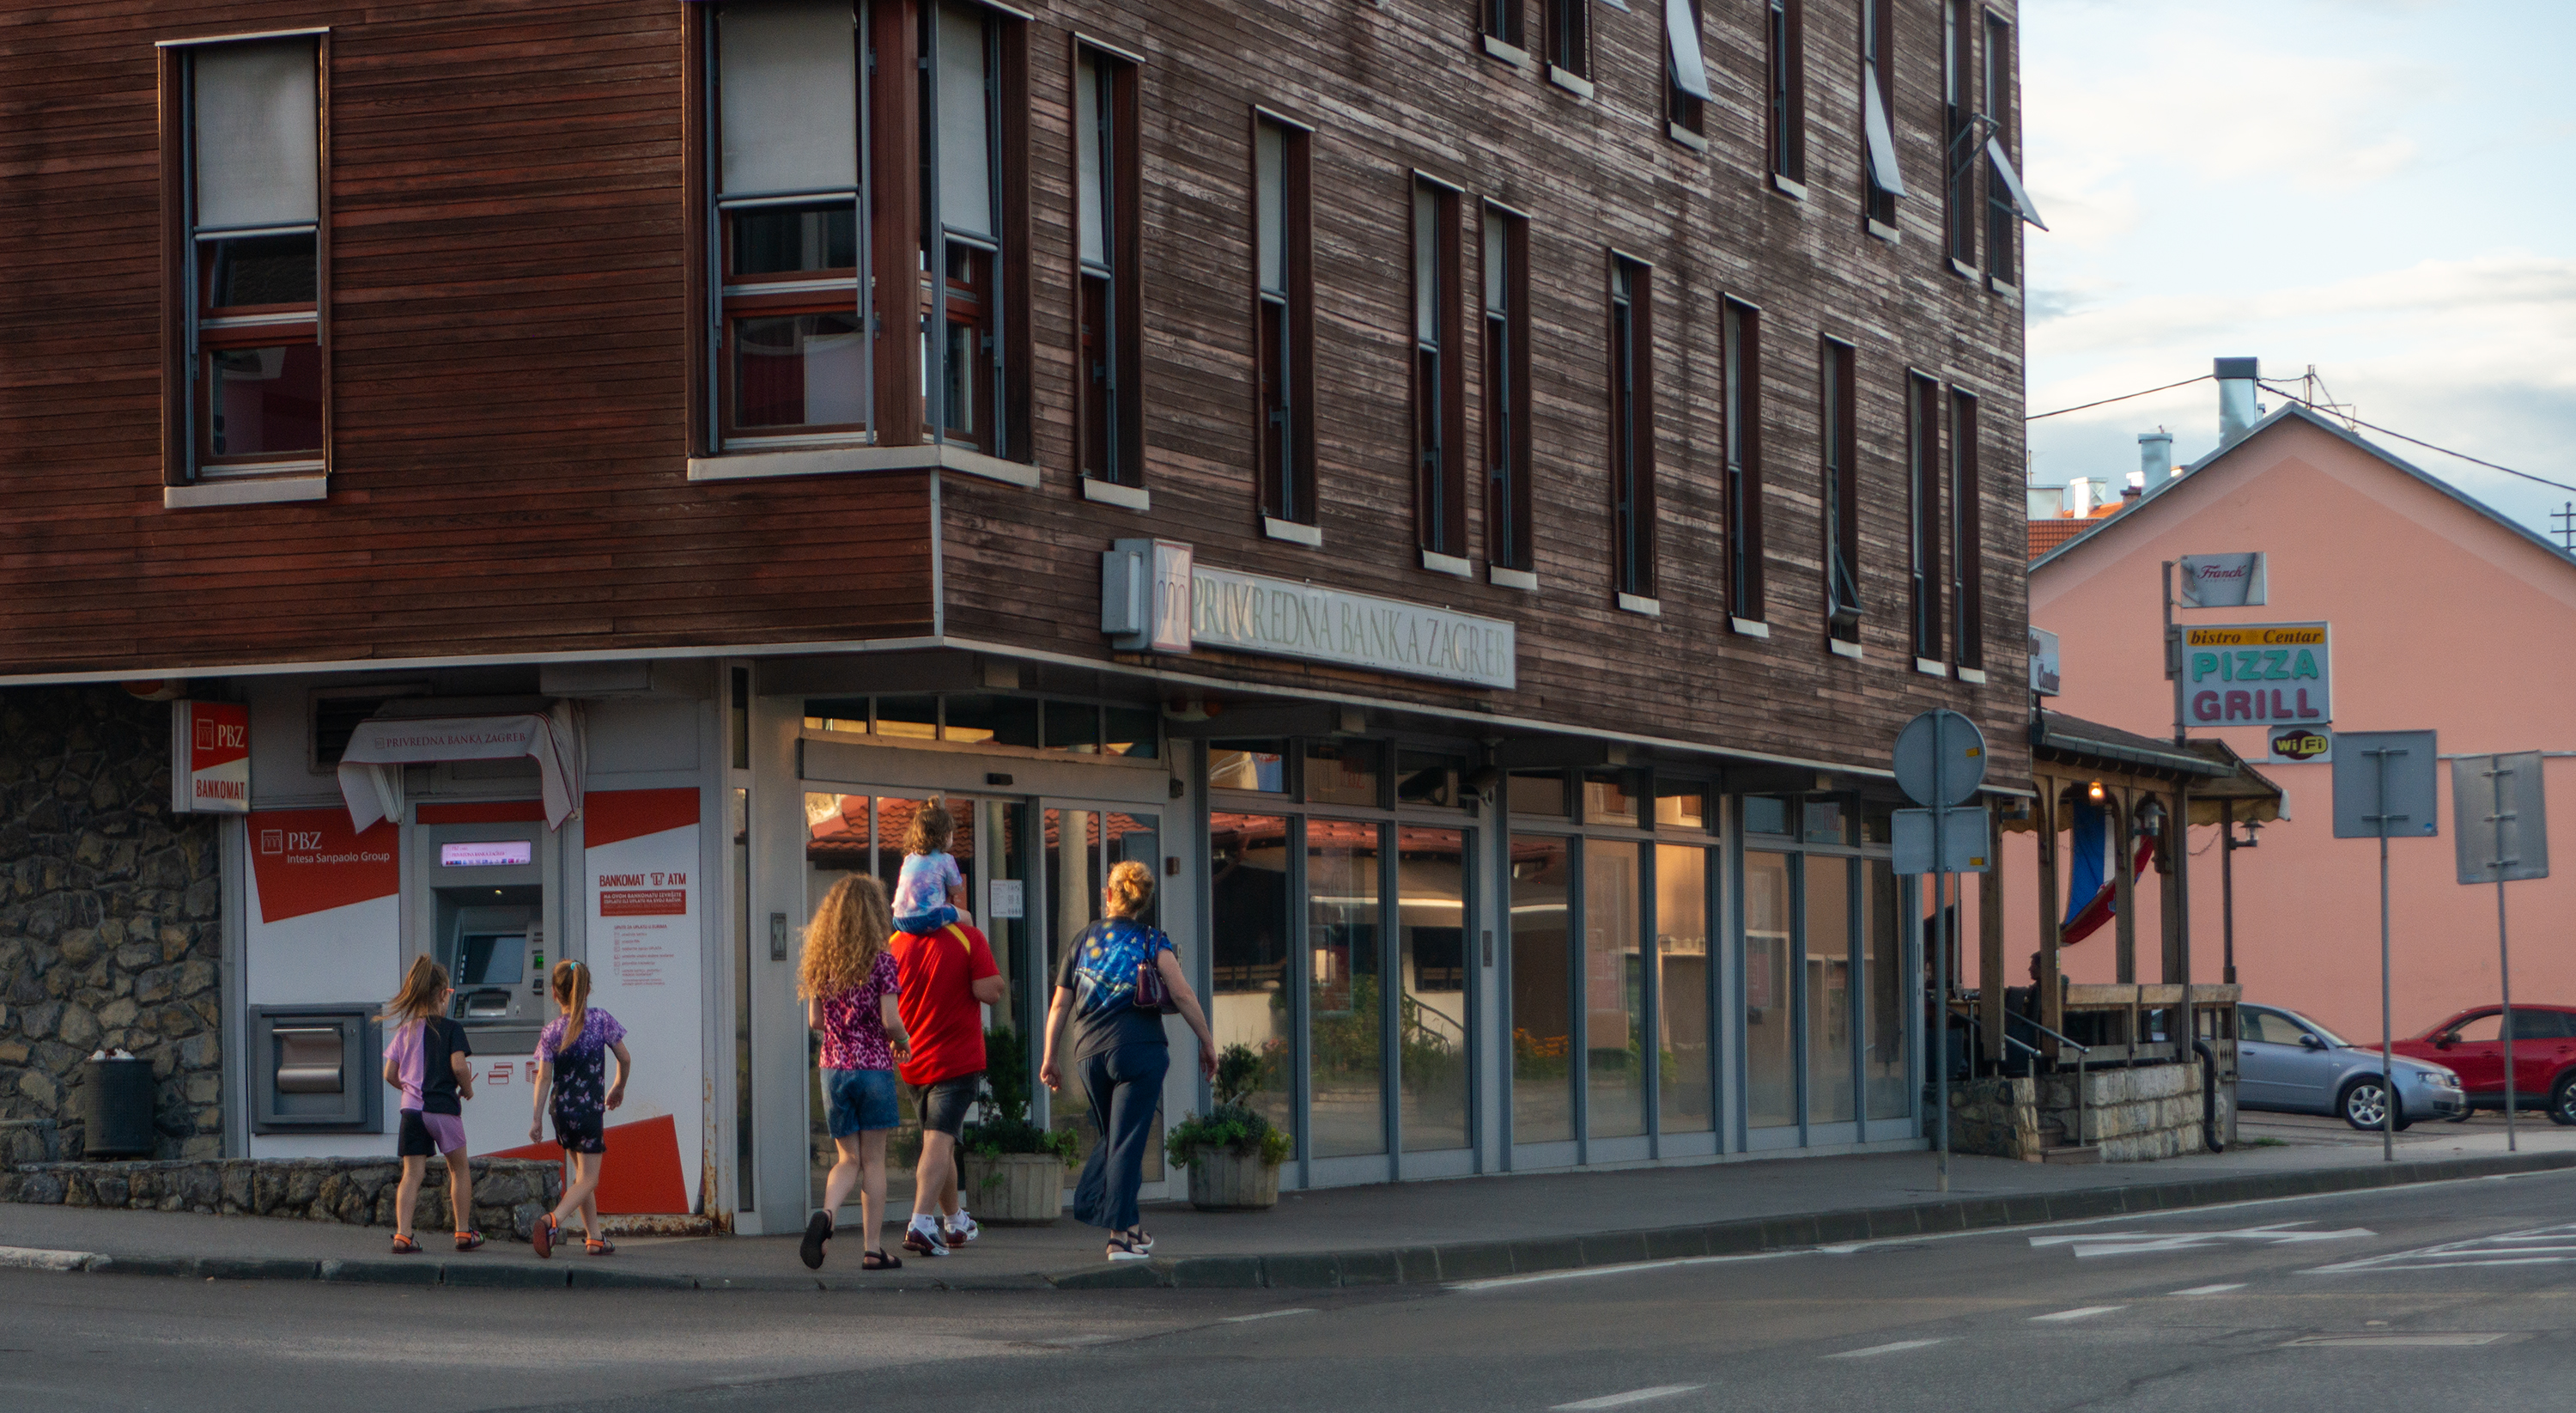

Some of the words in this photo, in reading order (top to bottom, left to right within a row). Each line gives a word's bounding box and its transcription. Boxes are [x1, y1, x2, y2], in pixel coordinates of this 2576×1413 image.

[2197, 564, 2246, 579] Franck
[1191, 575, 1334, 650] PRIVREDNA
[1340, 605, 1422, 666] BANKA
[1425, 618, 1507, 679] ZAGREB
[2190, 630, 2241, 644] bistro
[2263, 629, 2321, 643] Centar
[2191, 649, 2318, 682] PIZZA
[2192, 688, 2320, 722] GRILL
[217, 724, 245, 747] PBZ
[386, 735, 445, 748] PRIVREDNA
[447, 734, 483, 745] BANKA
[485, 732, 526, 743] ZAGREB
[196, 779, 246, 800] BANKOMAT
[288, 831, 322, 850] PBZ
[287, 854, 313, 863] Intesa
[316, 851, 359, 865] Sanpaolo
[361, 851, 390, 863] Group
[599, 874, 645, 887] BANKOMAT
[667, 872, 687, 886] ATM
